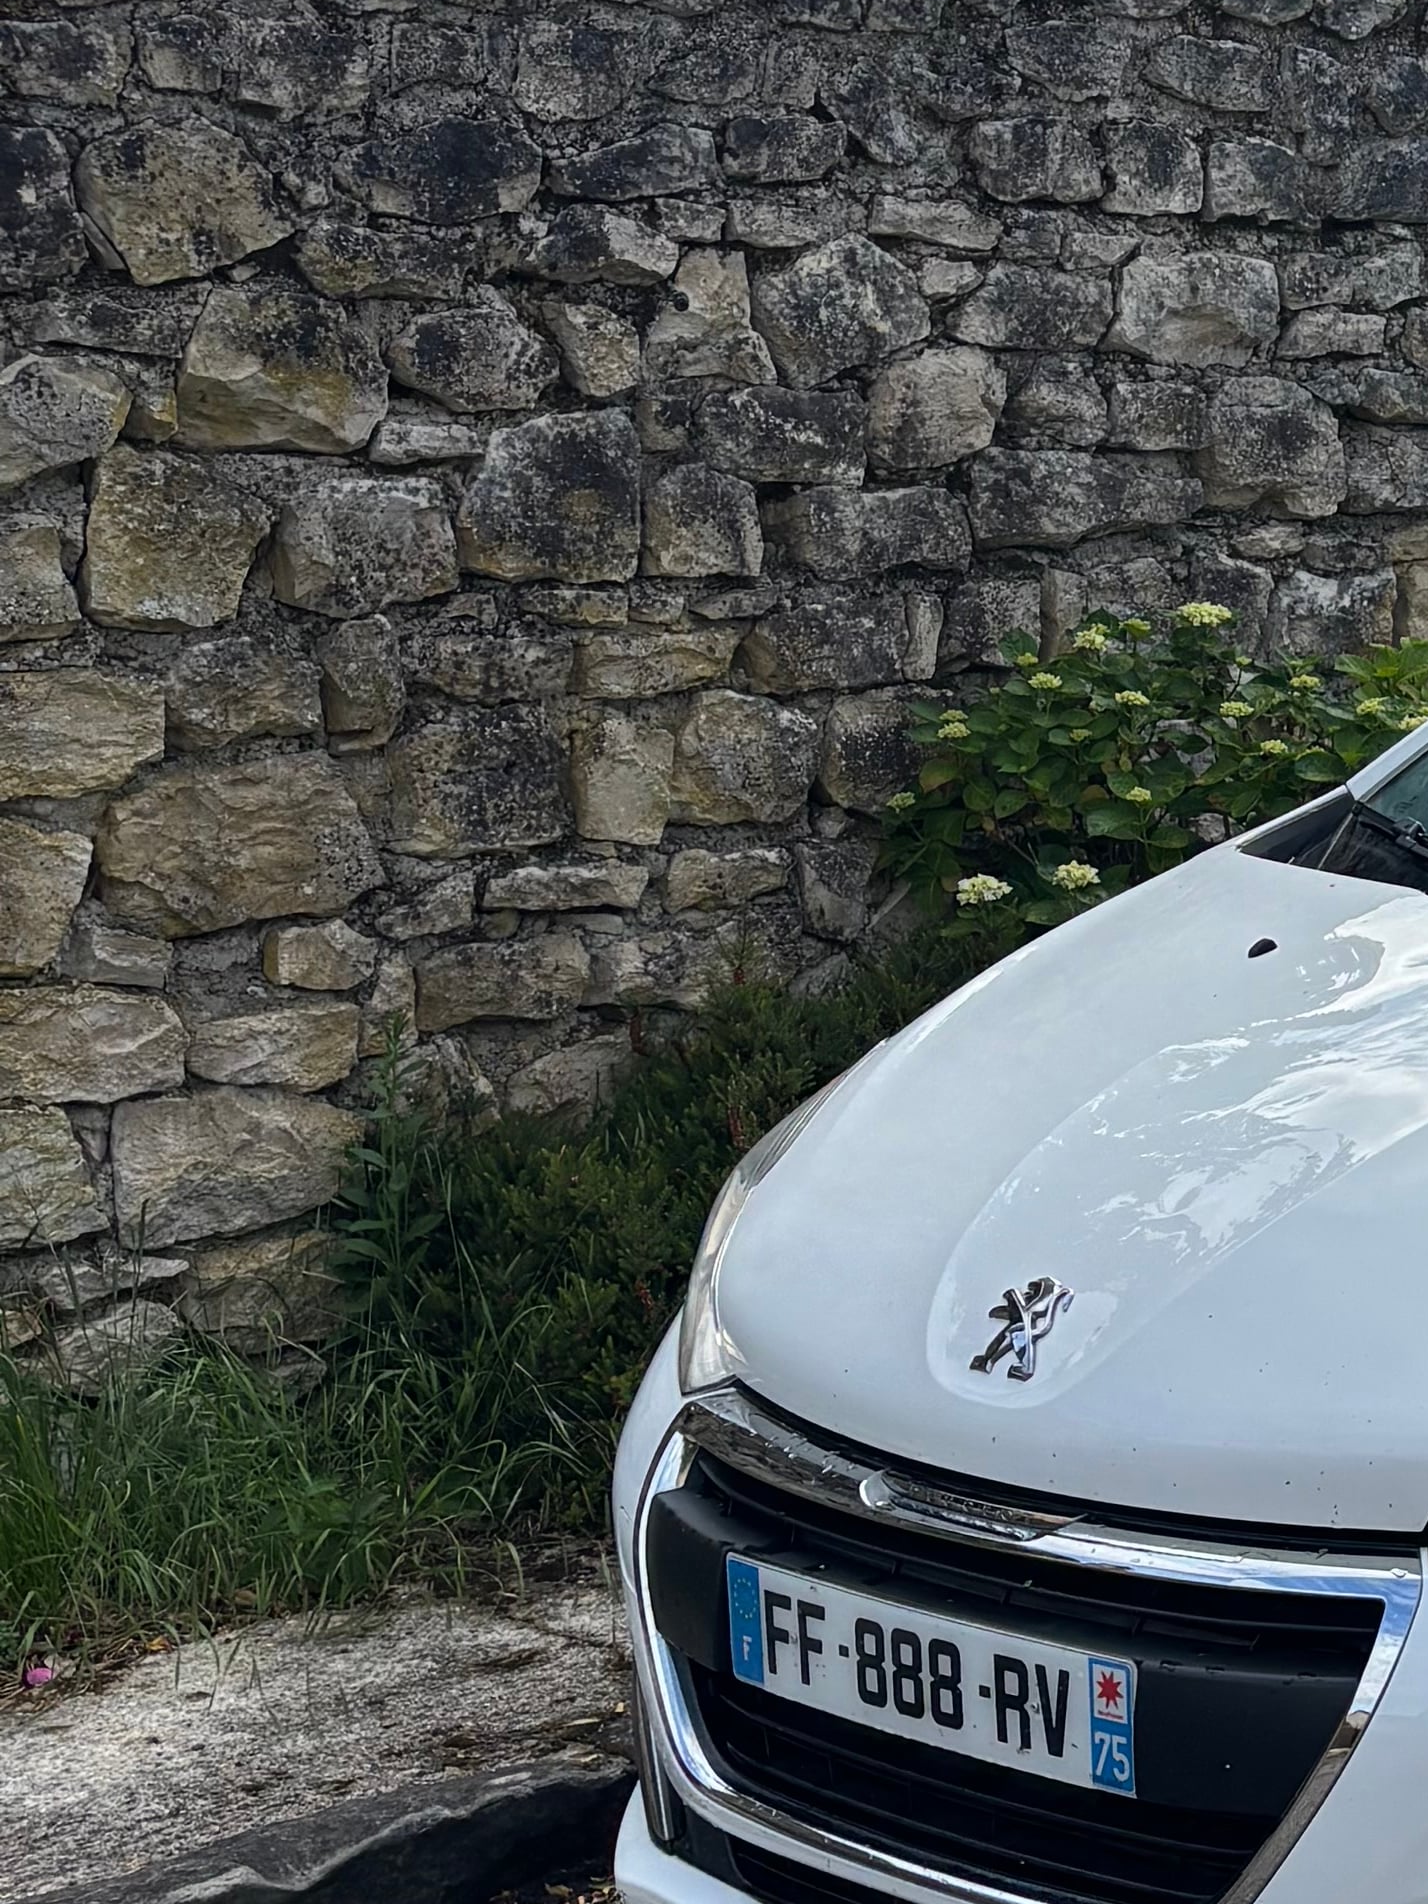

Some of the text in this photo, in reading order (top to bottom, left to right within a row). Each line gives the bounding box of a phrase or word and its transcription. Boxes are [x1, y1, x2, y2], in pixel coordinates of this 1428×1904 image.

[742, 1635, 752, 1661] F
[763, 1589, 1070, 1758] FF-888-RV
[1093, 1731, 1130, 1783] 75
